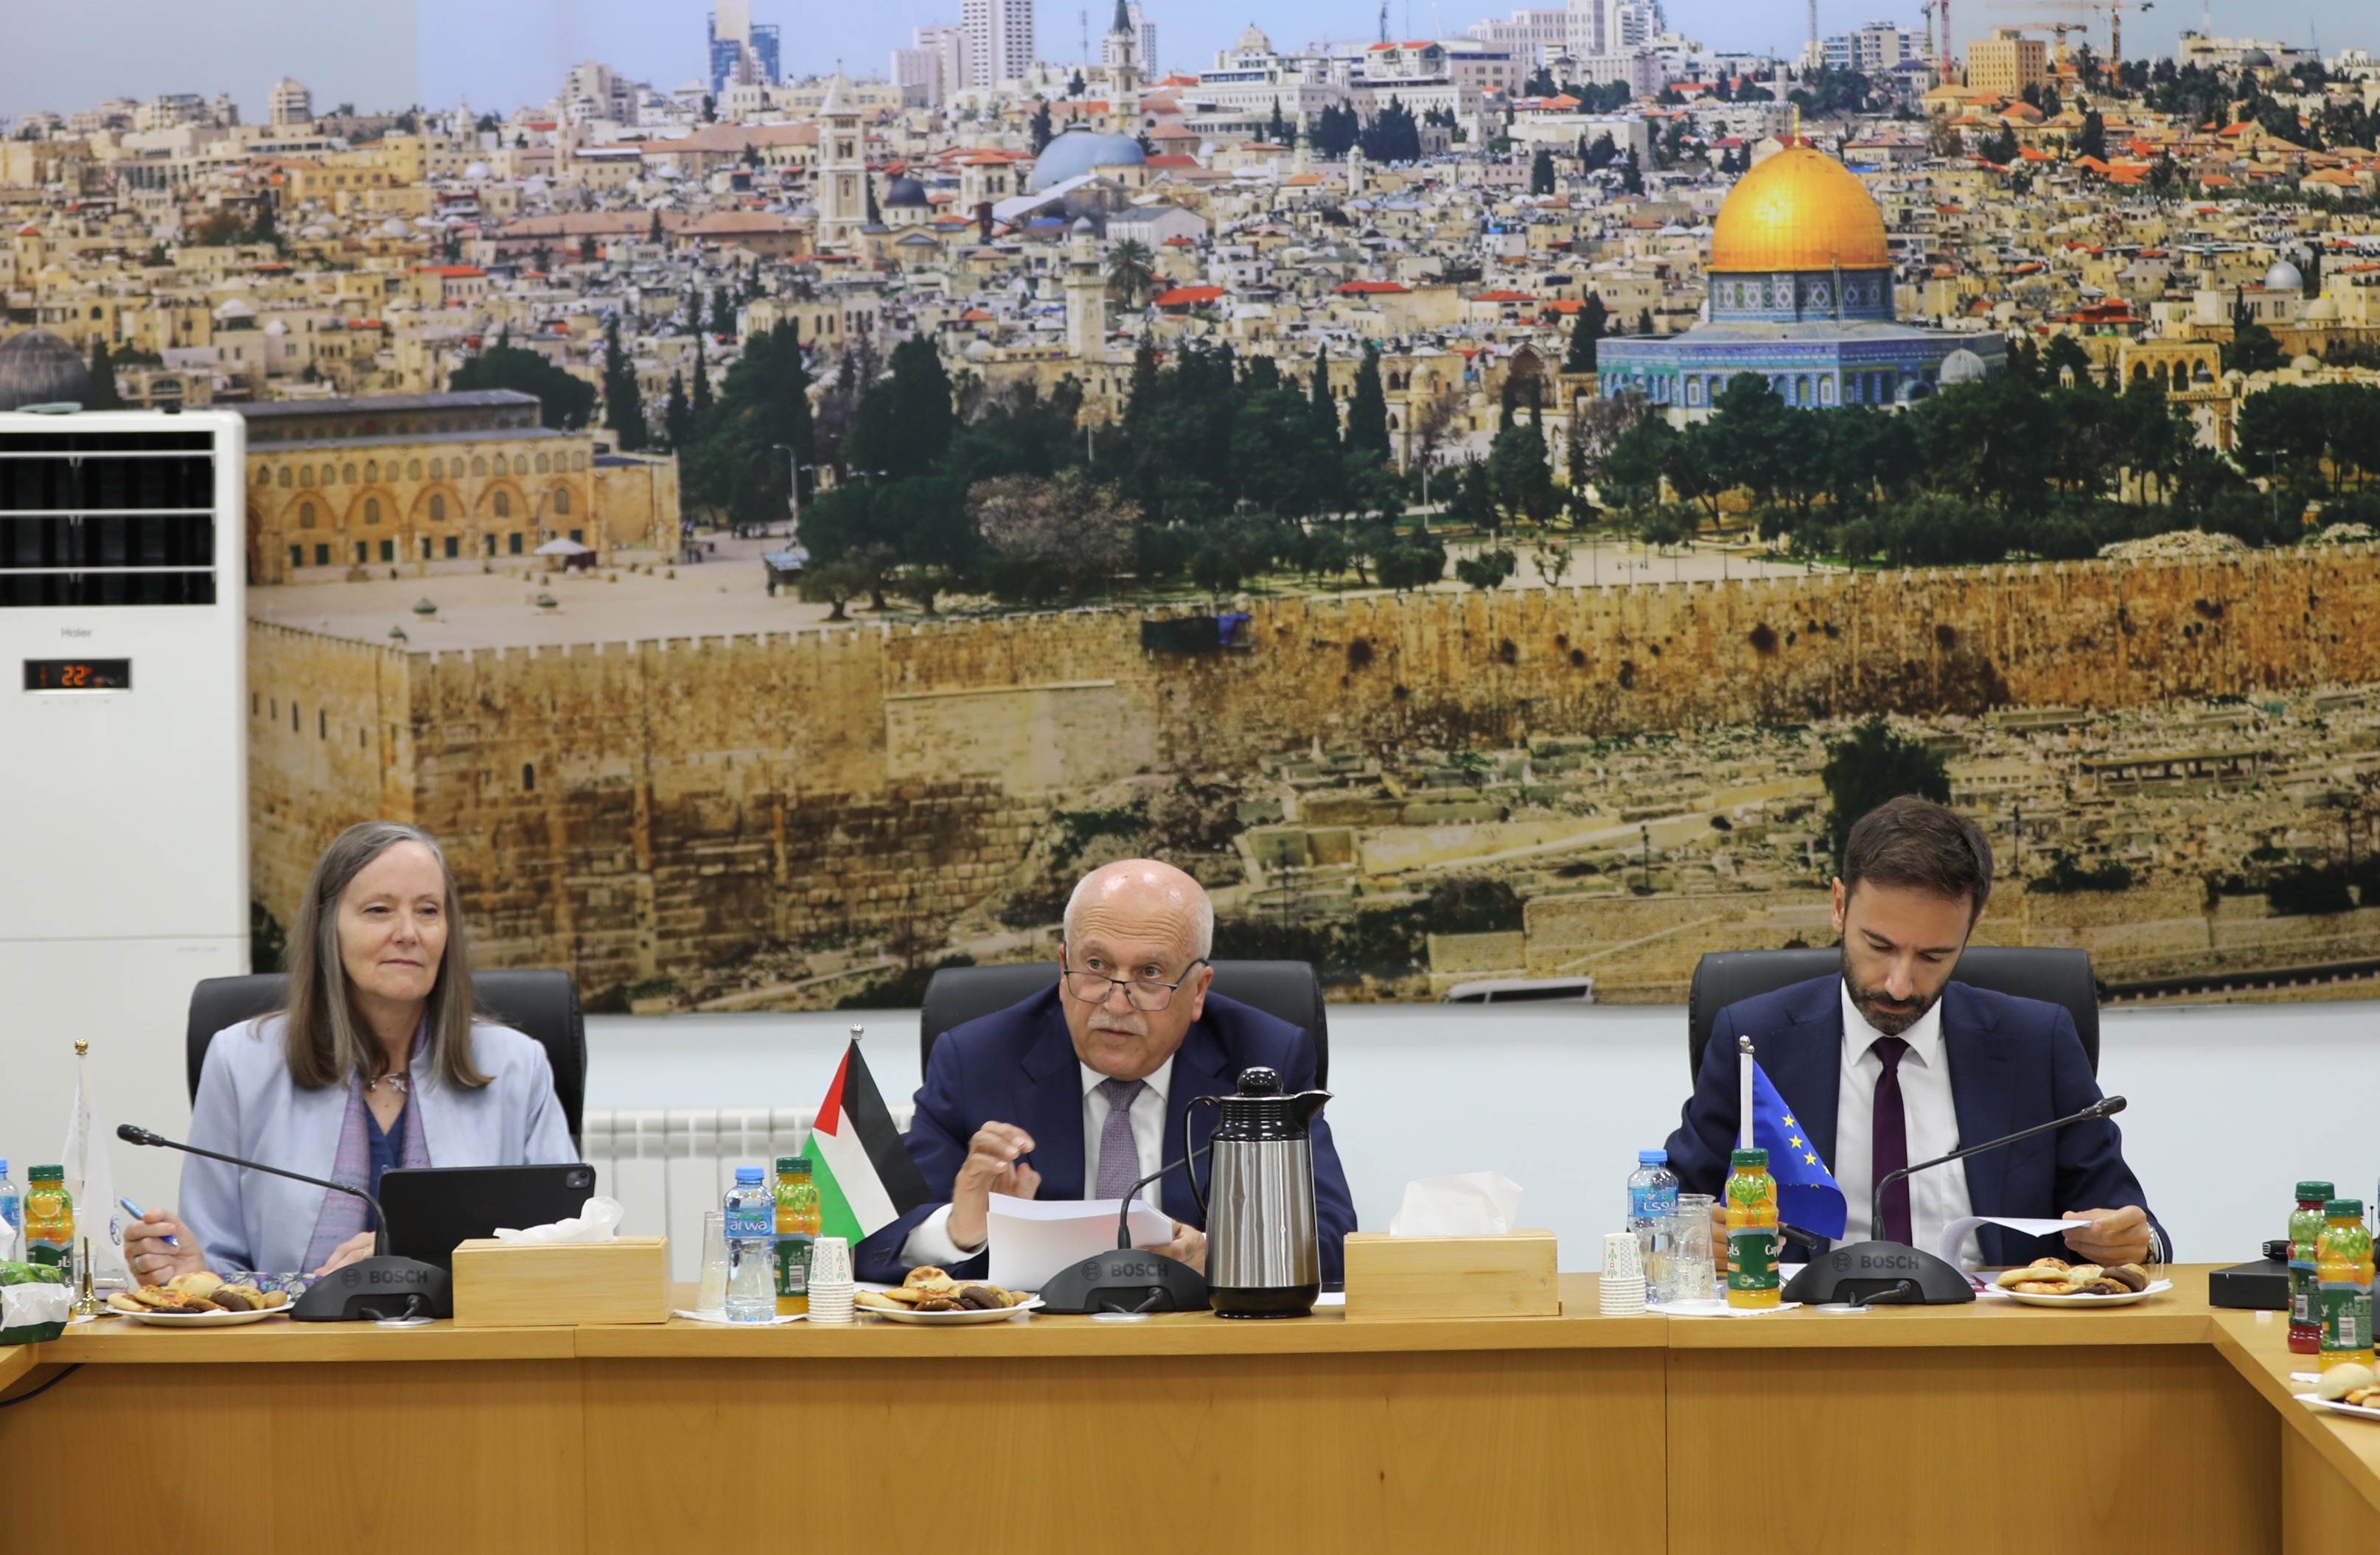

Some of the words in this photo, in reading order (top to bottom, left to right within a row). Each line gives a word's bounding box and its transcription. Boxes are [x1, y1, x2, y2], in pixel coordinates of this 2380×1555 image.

[730, 1220, 767, 1231] arwa
[1860, 1255, 1919, 1269] BOSCH
[369, 1270, 428, 1284] BOSCH
[1111, 1263, 1168, 1277] BOSCH
